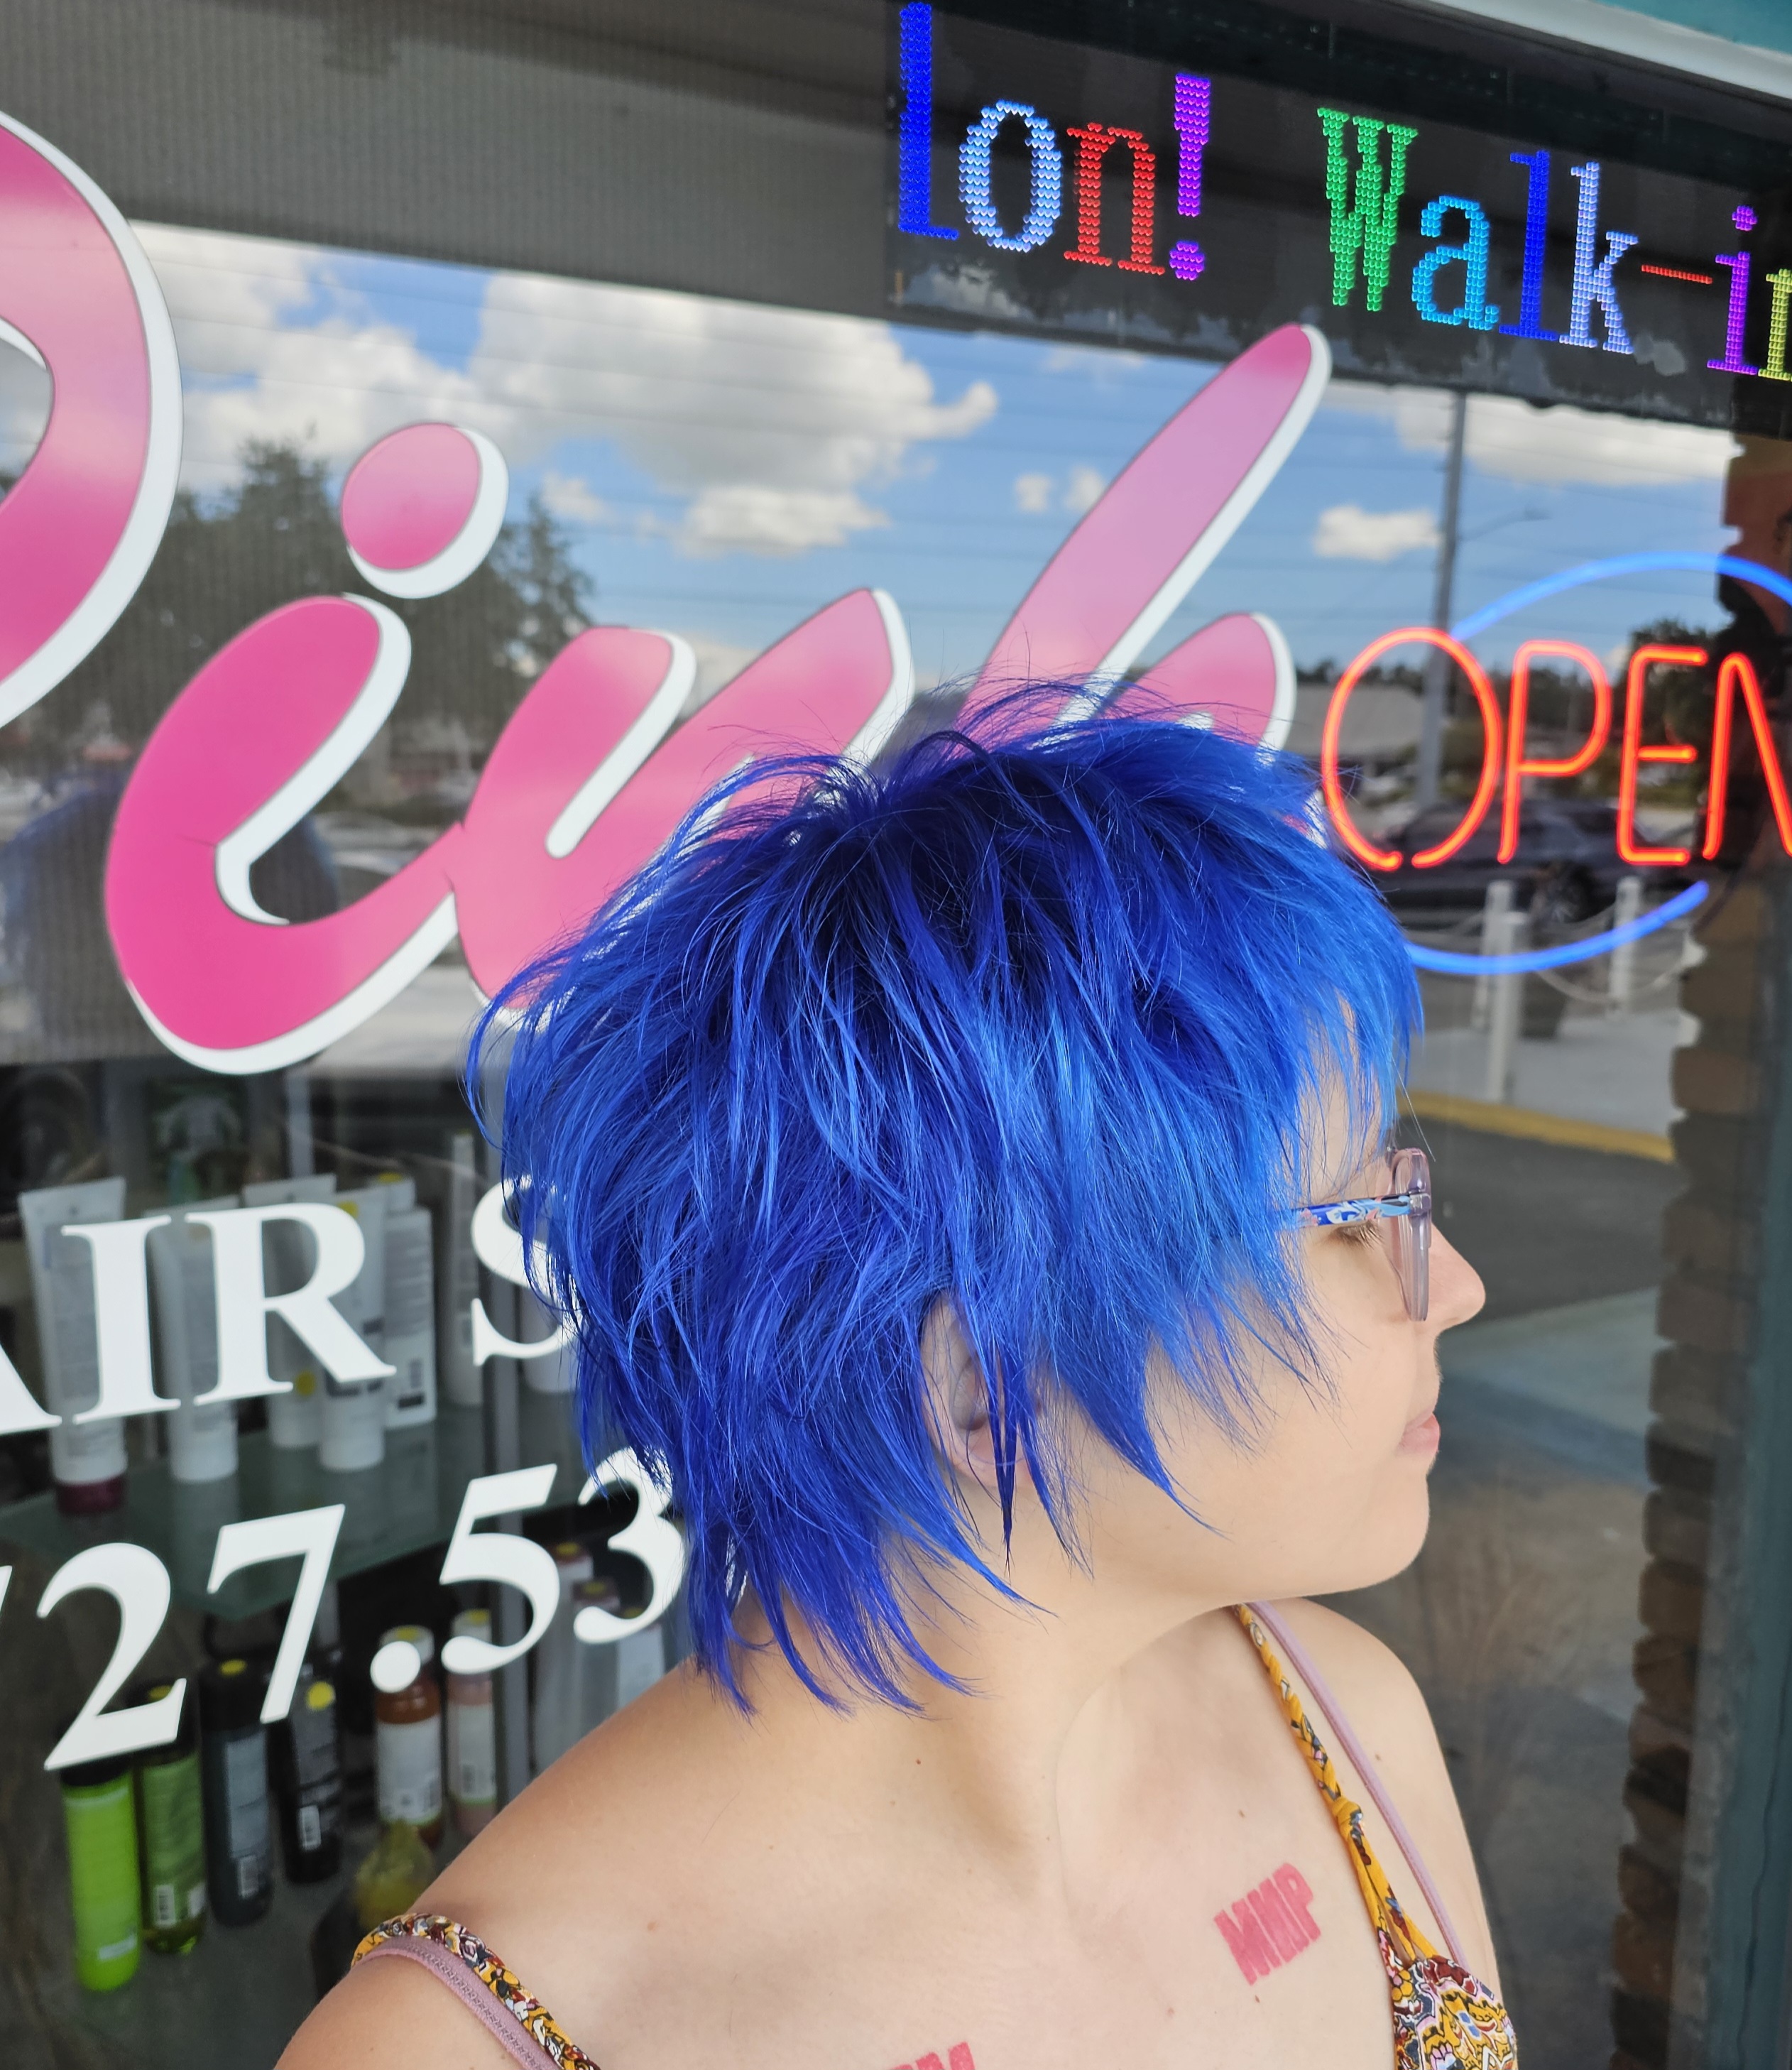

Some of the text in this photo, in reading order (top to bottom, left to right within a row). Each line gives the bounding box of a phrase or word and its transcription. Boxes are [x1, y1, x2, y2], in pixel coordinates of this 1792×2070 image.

[1322, 627, 1792, 871] OPEN
[0, 1202, 397, 1436] IR
[0, 1447, 686, 1770] 27.53
